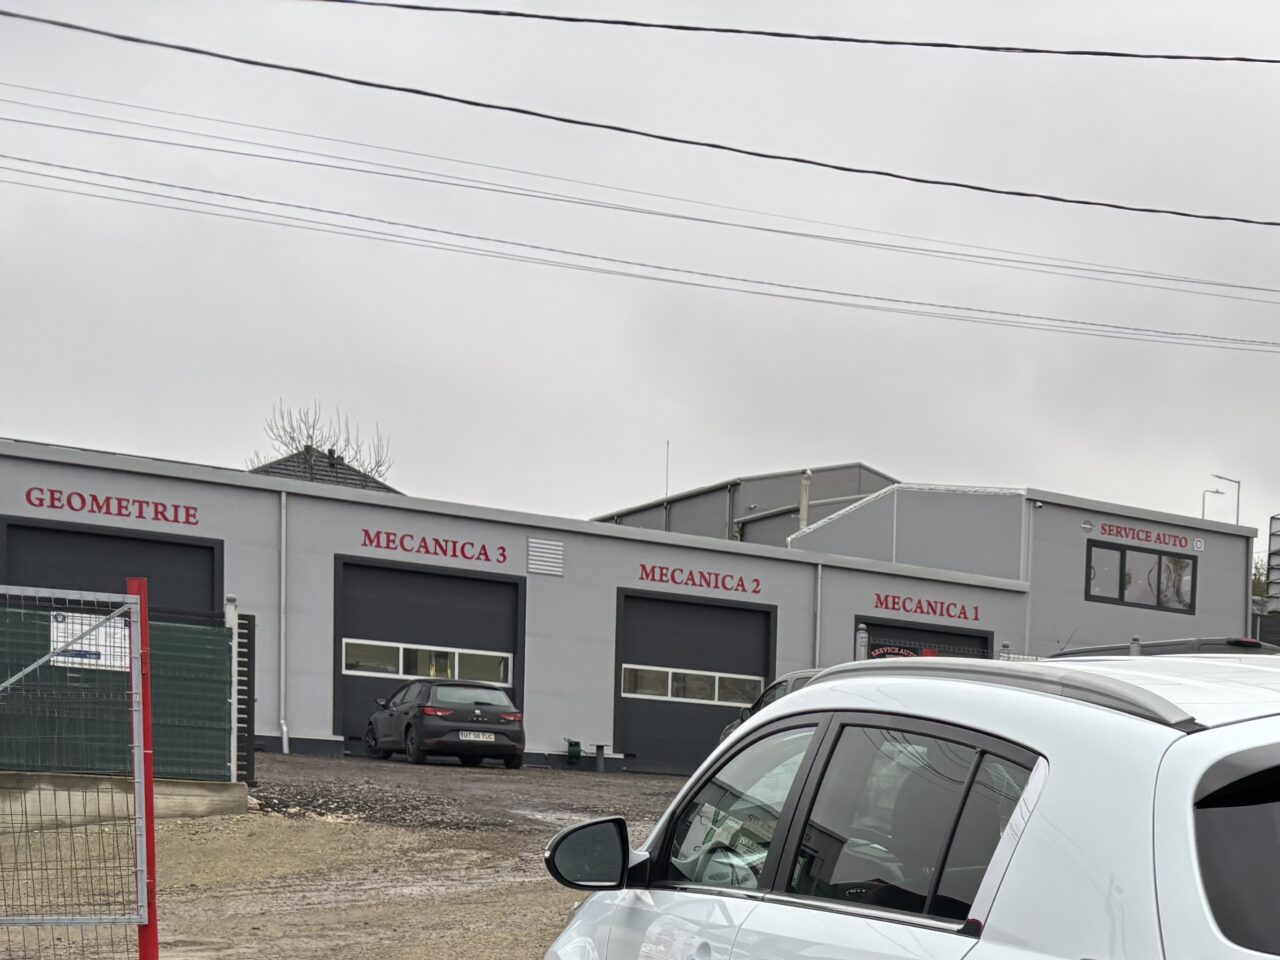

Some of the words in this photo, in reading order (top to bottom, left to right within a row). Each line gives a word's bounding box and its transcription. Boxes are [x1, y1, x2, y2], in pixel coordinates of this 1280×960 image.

[25, 487, 200, 526] GEOMETRIE
[361, 528, 491, 562] MECANICA
[496, 546, 507, 564] 3
[1100, 523, 1152, 543] SERVICE
[1154, 532, 1188, 548] AUTO
[639, 563, 748, 592] MECANICA
[751, 578, 761, 594] 2
[874, 593, 969, 620] MECANICA
[972, 605, 980, 621] 1
